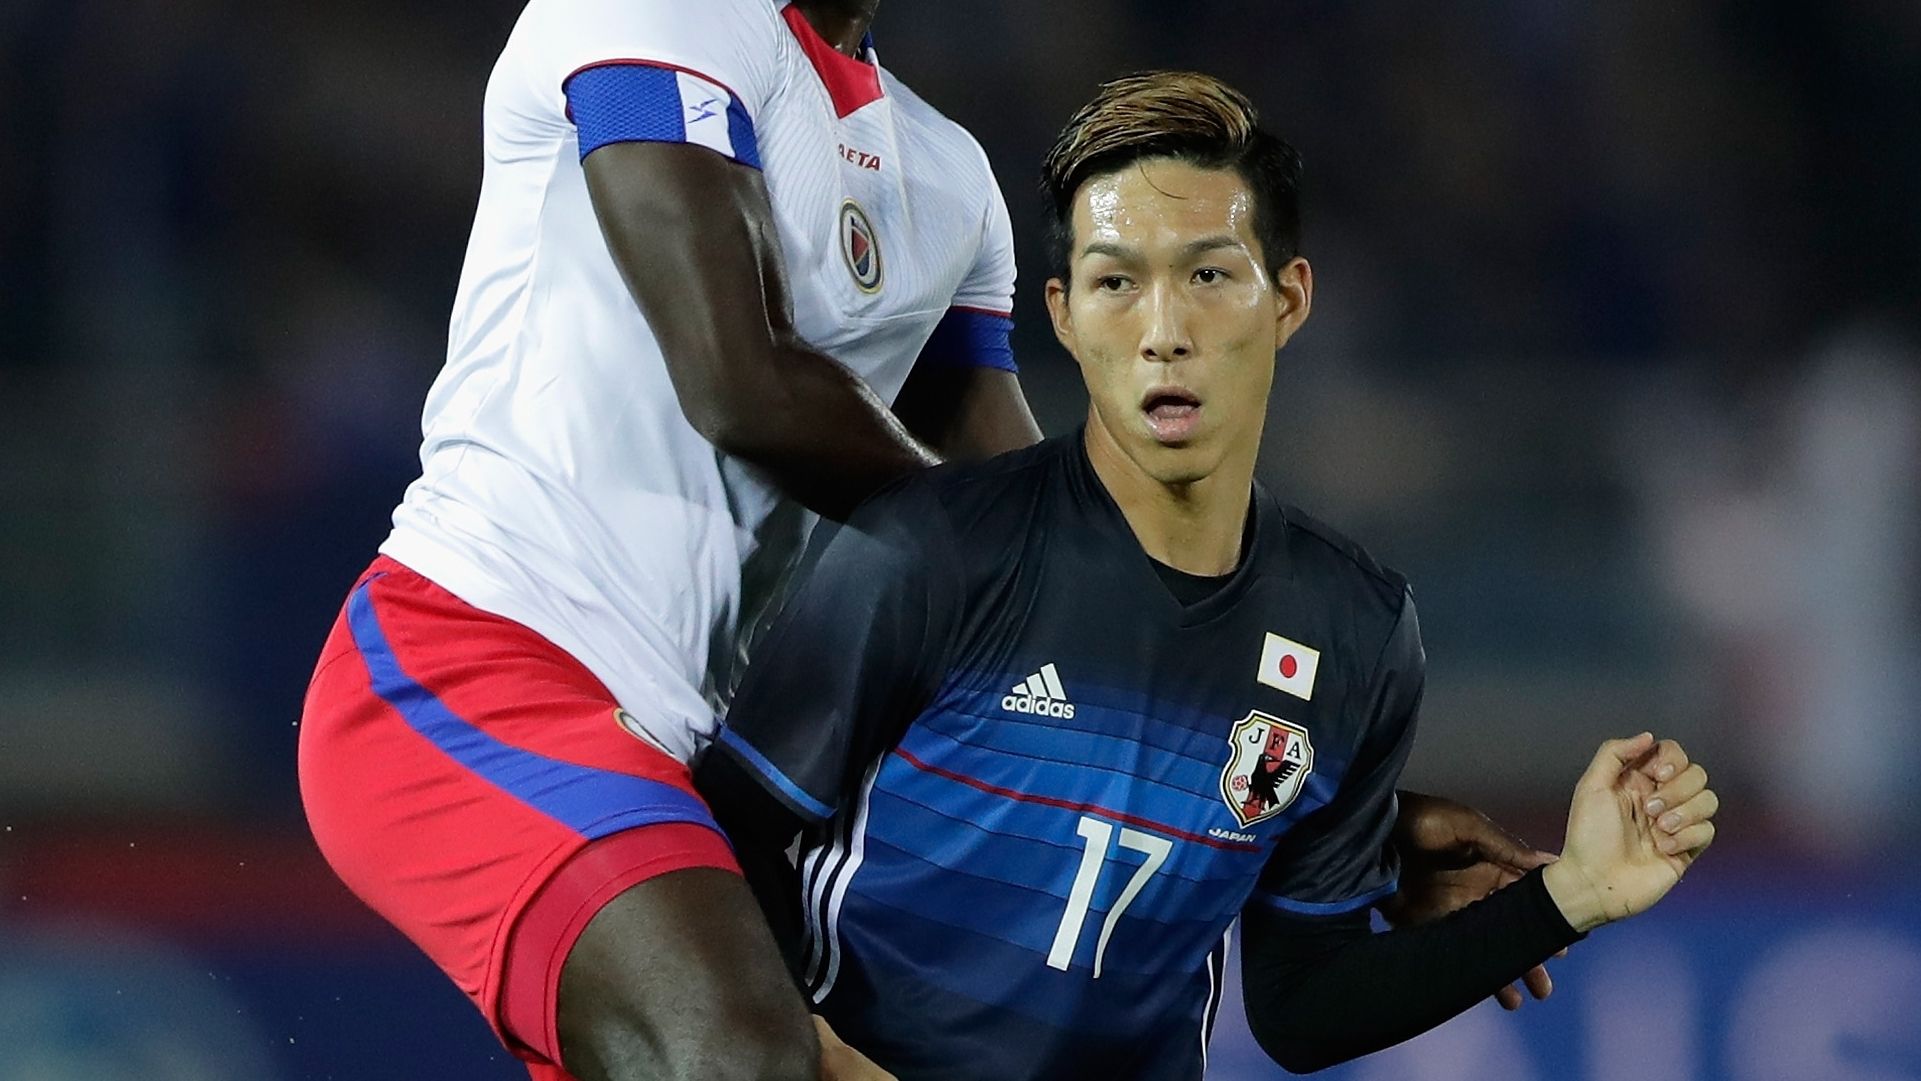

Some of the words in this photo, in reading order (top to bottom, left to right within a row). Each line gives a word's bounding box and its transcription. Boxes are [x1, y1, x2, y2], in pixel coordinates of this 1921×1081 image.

[1001, 694, 1075, 719] adidas
[1248, 727, 1301, 760] JFA
[1208, 828, 1256, 842] JAPAN
[1046, 815, 1173, 979] 17
